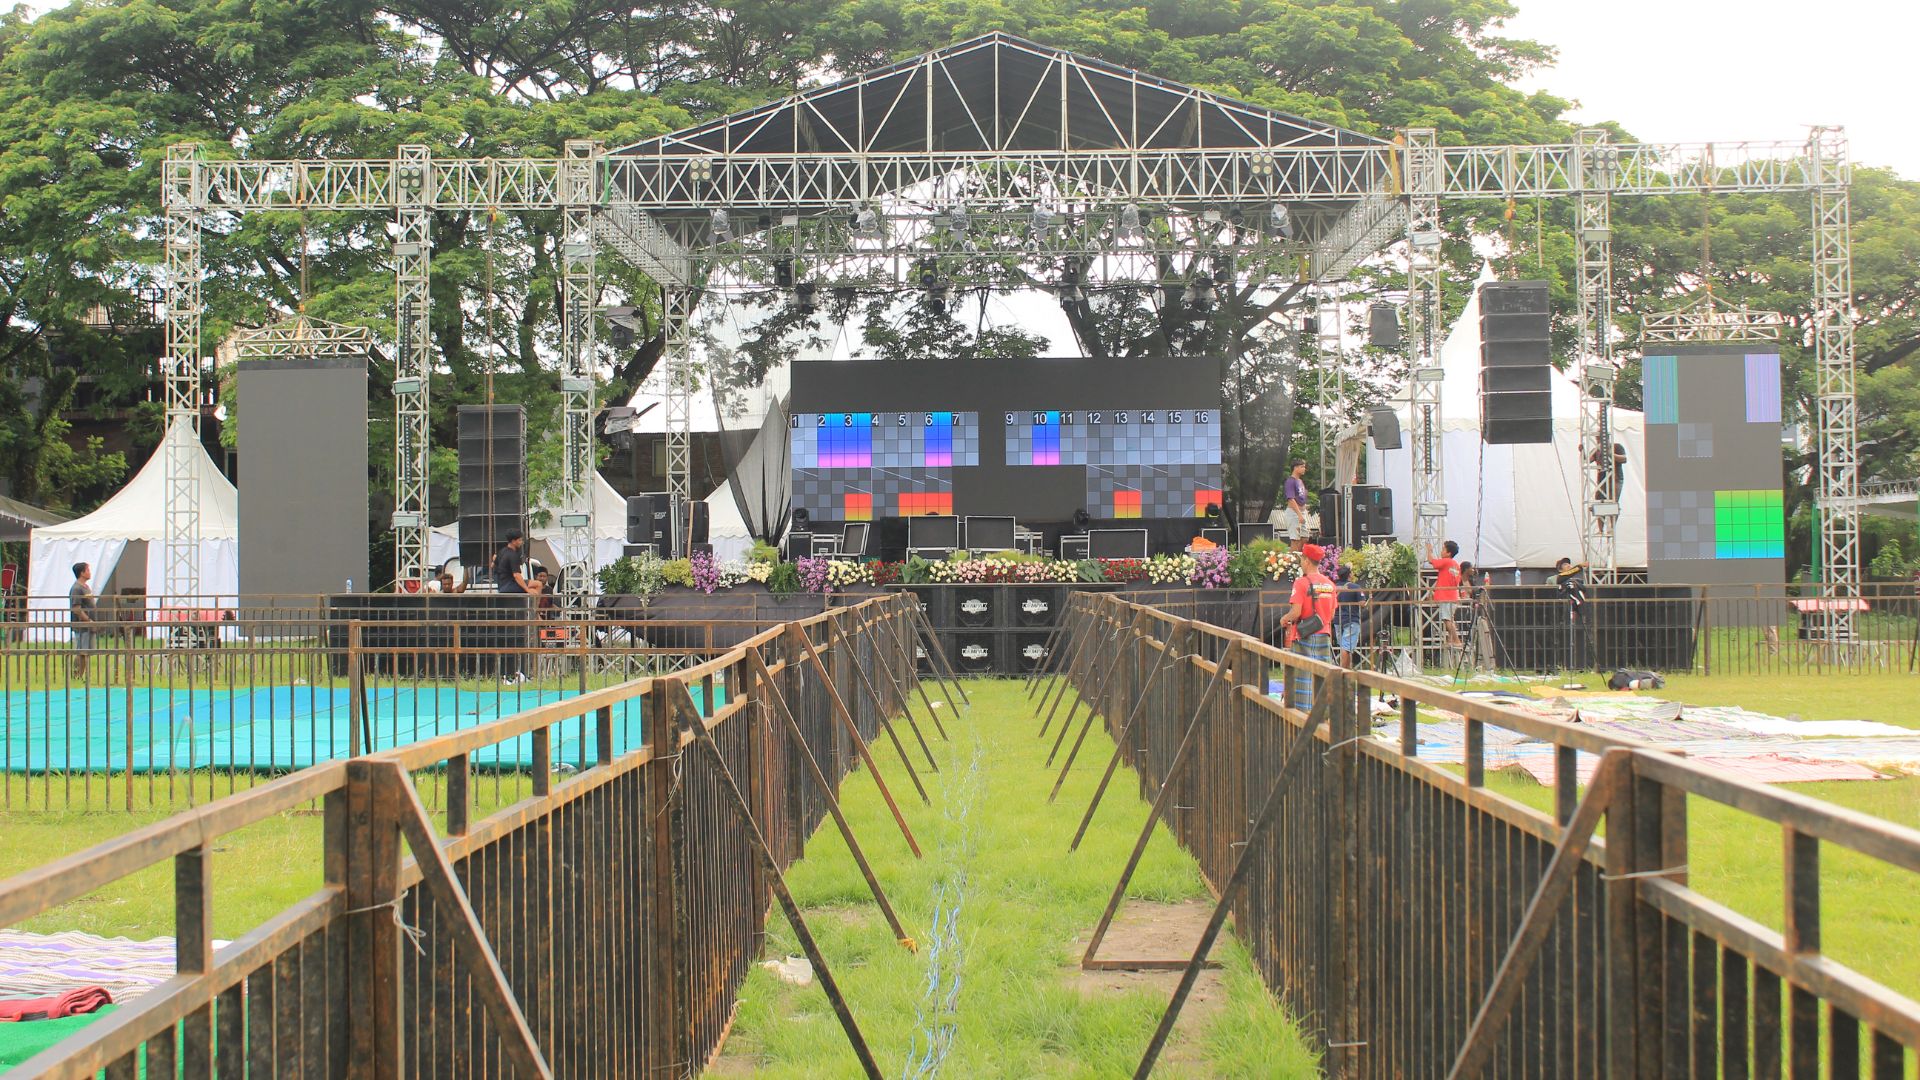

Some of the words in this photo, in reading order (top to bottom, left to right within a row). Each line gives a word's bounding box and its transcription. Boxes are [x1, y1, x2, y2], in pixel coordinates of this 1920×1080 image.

[792, 415, 798, 427] 1
[818, 415, 826, 427] 2
[844, 415, 852, 426] 3
[871, 415, 879, 426] 4
[898, 414, 906, 426] 5
[925, 414, 933, 425] 6
[952, 414, 960, 425] 7
[1006, 413, 1014, 425] 9
[1034, 413, 1047, 424] 10
[1061, 413, 1073, 424] 11
[1088, 413, 1101, 424] 12
[1115, 413, 1128, 424] 13
[1141, 412, 1155, 423] 14
[1168, 412, 1182, 423] 15
[1195, 412, 1209, 423] 16
